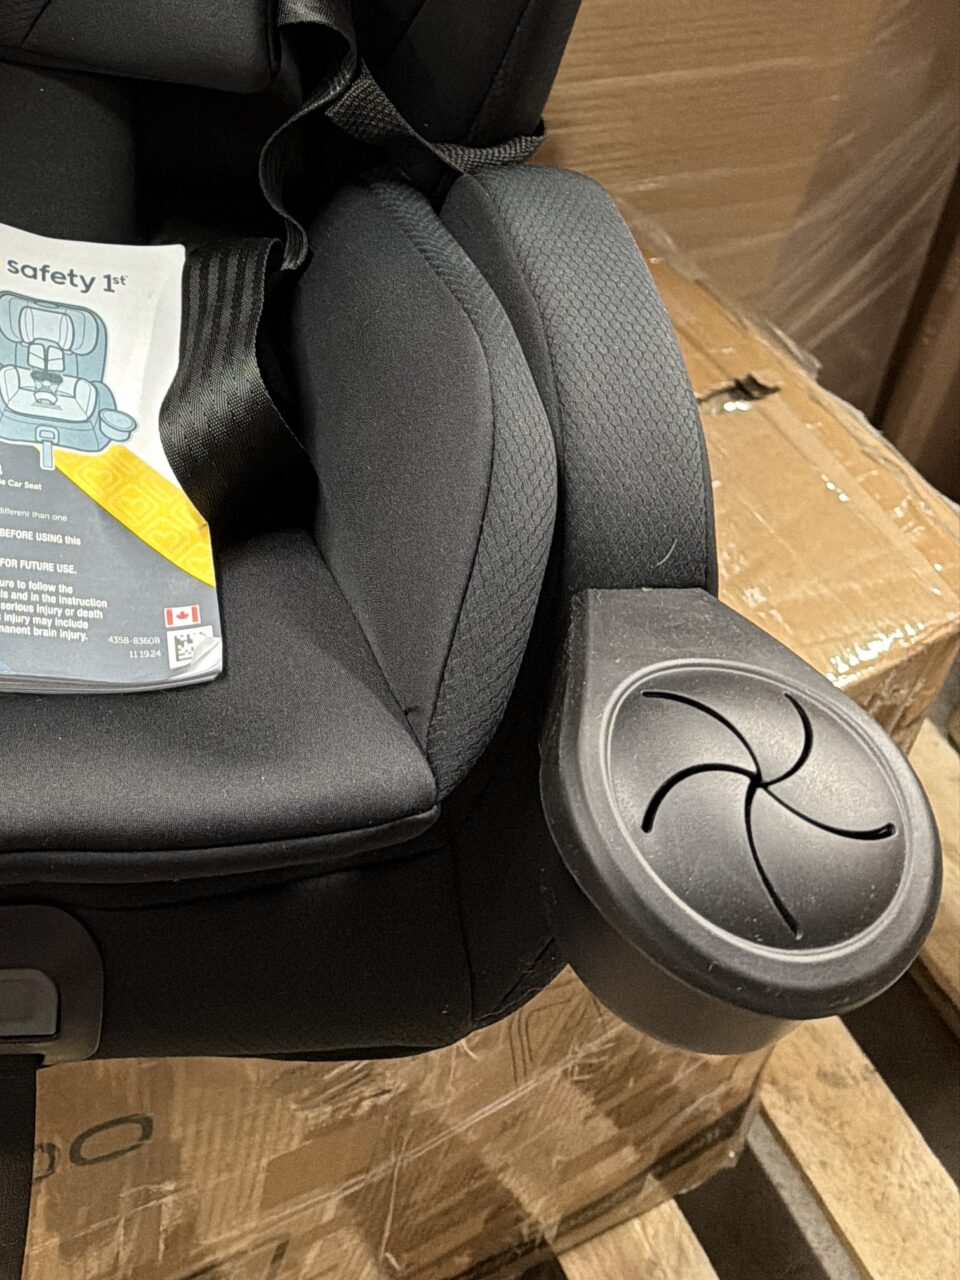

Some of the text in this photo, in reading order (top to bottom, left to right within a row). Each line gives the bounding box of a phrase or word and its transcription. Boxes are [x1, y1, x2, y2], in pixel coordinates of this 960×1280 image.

[7, 259, 96, 294] safety
[7, 478, 23, 488] Car
[24, 481, 42, 491] Seat
[32, 511, 50, 520] than
[51, 514, 68, 522] one
[0, 527, 34, 540] BEFORE
[35, 531, 63, 544] USING
[64, 535, 82, 546] this
[0, 557, 18, 569] FOR
[19, 559, 55, 572] FUTURE
[56, 563, 77, 575] USE.
[16, 580, 26, 589] to
[28, 581, 56, 593] follow
[58, 584, 73, 594] the
[10, 591, 28, 601] and
[30, 592, 40, 602] in
[41, 593, 57, 604] the
[58, 594, 108, 608] instruction
[0, 602, 35, 613] serious
[36, 603, 63, 617] injury
[64, 608, 75, 616] or
[76, 608, 104, 619] death
[3, 612, 31, 625] injury
[32, 616, 53, 626] may
[54, 616, 89, 630] include
[33, 626, 58, 638] brain
[59, 628, 89, 642] injury.
